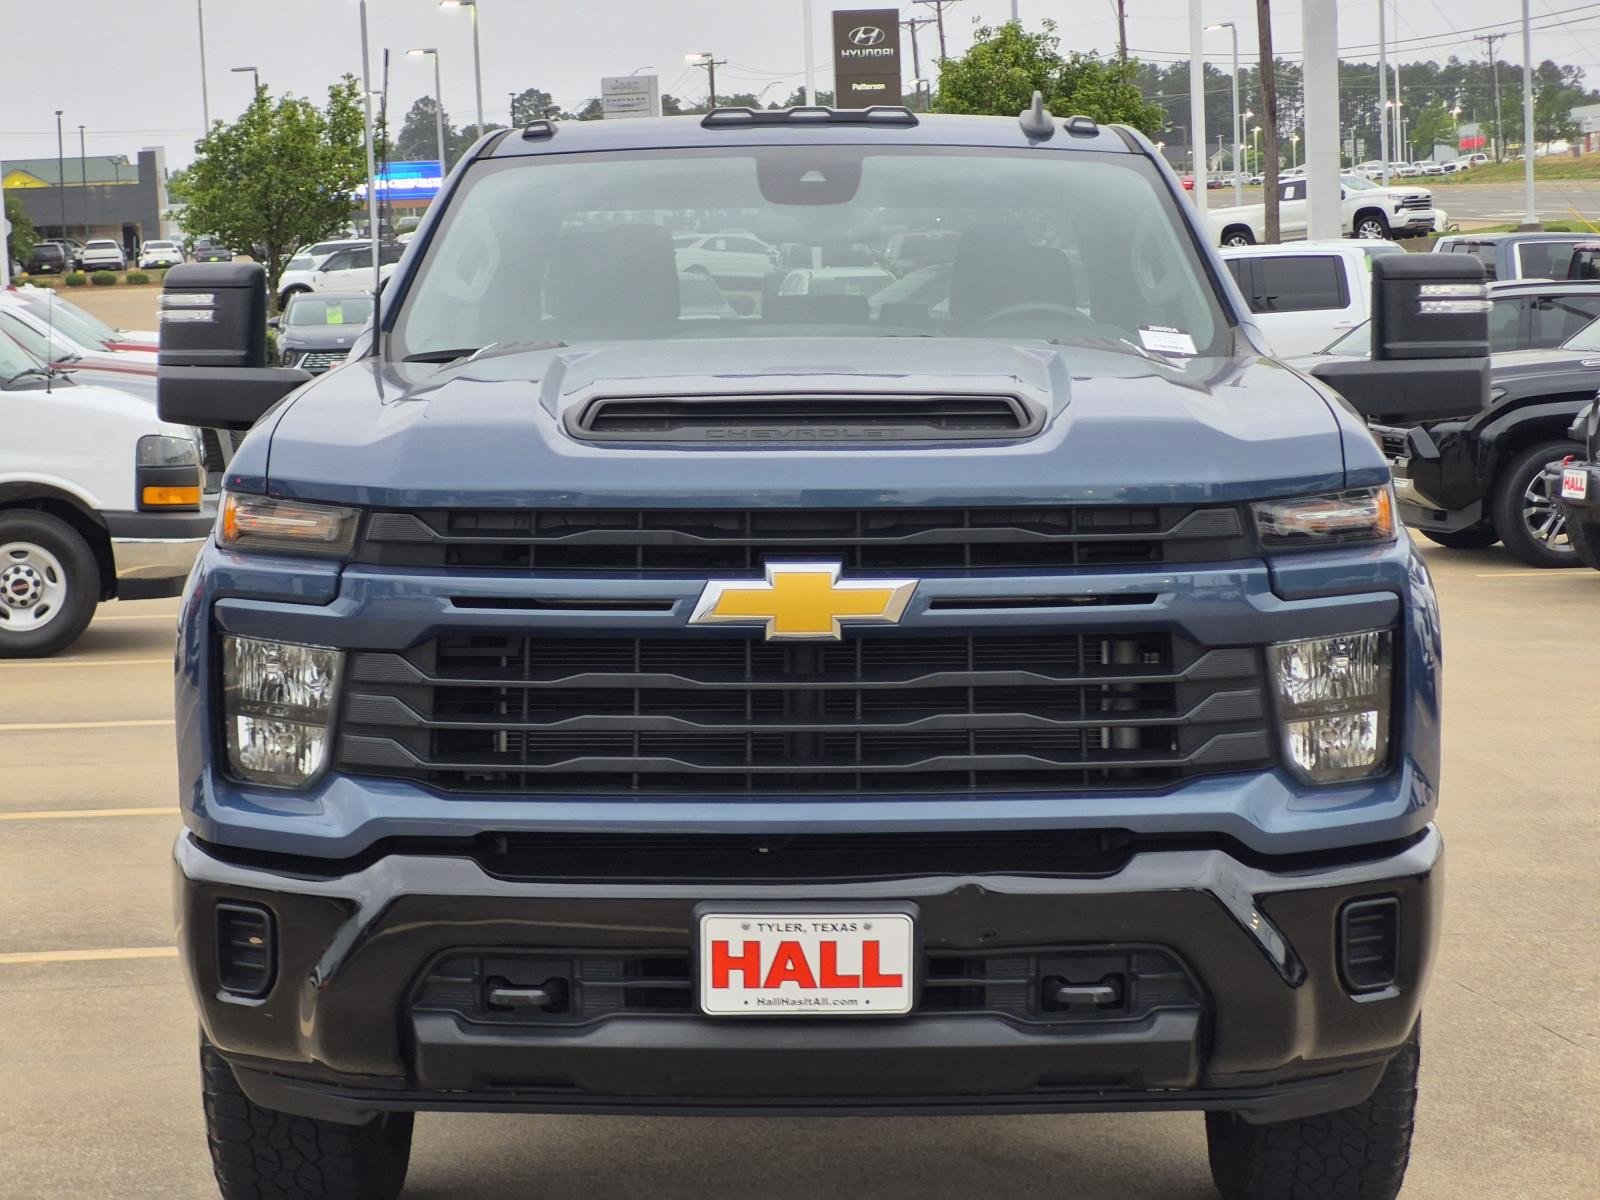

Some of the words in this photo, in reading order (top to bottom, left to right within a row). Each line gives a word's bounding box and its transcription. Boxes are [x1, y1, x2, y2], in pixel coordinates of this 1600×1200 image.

[841, 48, 894, 58] HYUNDAI
[852, 83, 886, 91] Patterson
[705, 428, 905, 439] CHEVROLET
[1564, 475, 1585, 492] HALL
[757, 922, 807, 934] TYLER,
[812, 922, 858, 932] TEXAS
[711, 939, 904, 989] HALL
[757, 996, 859, 1007] HallHasItAll.com
